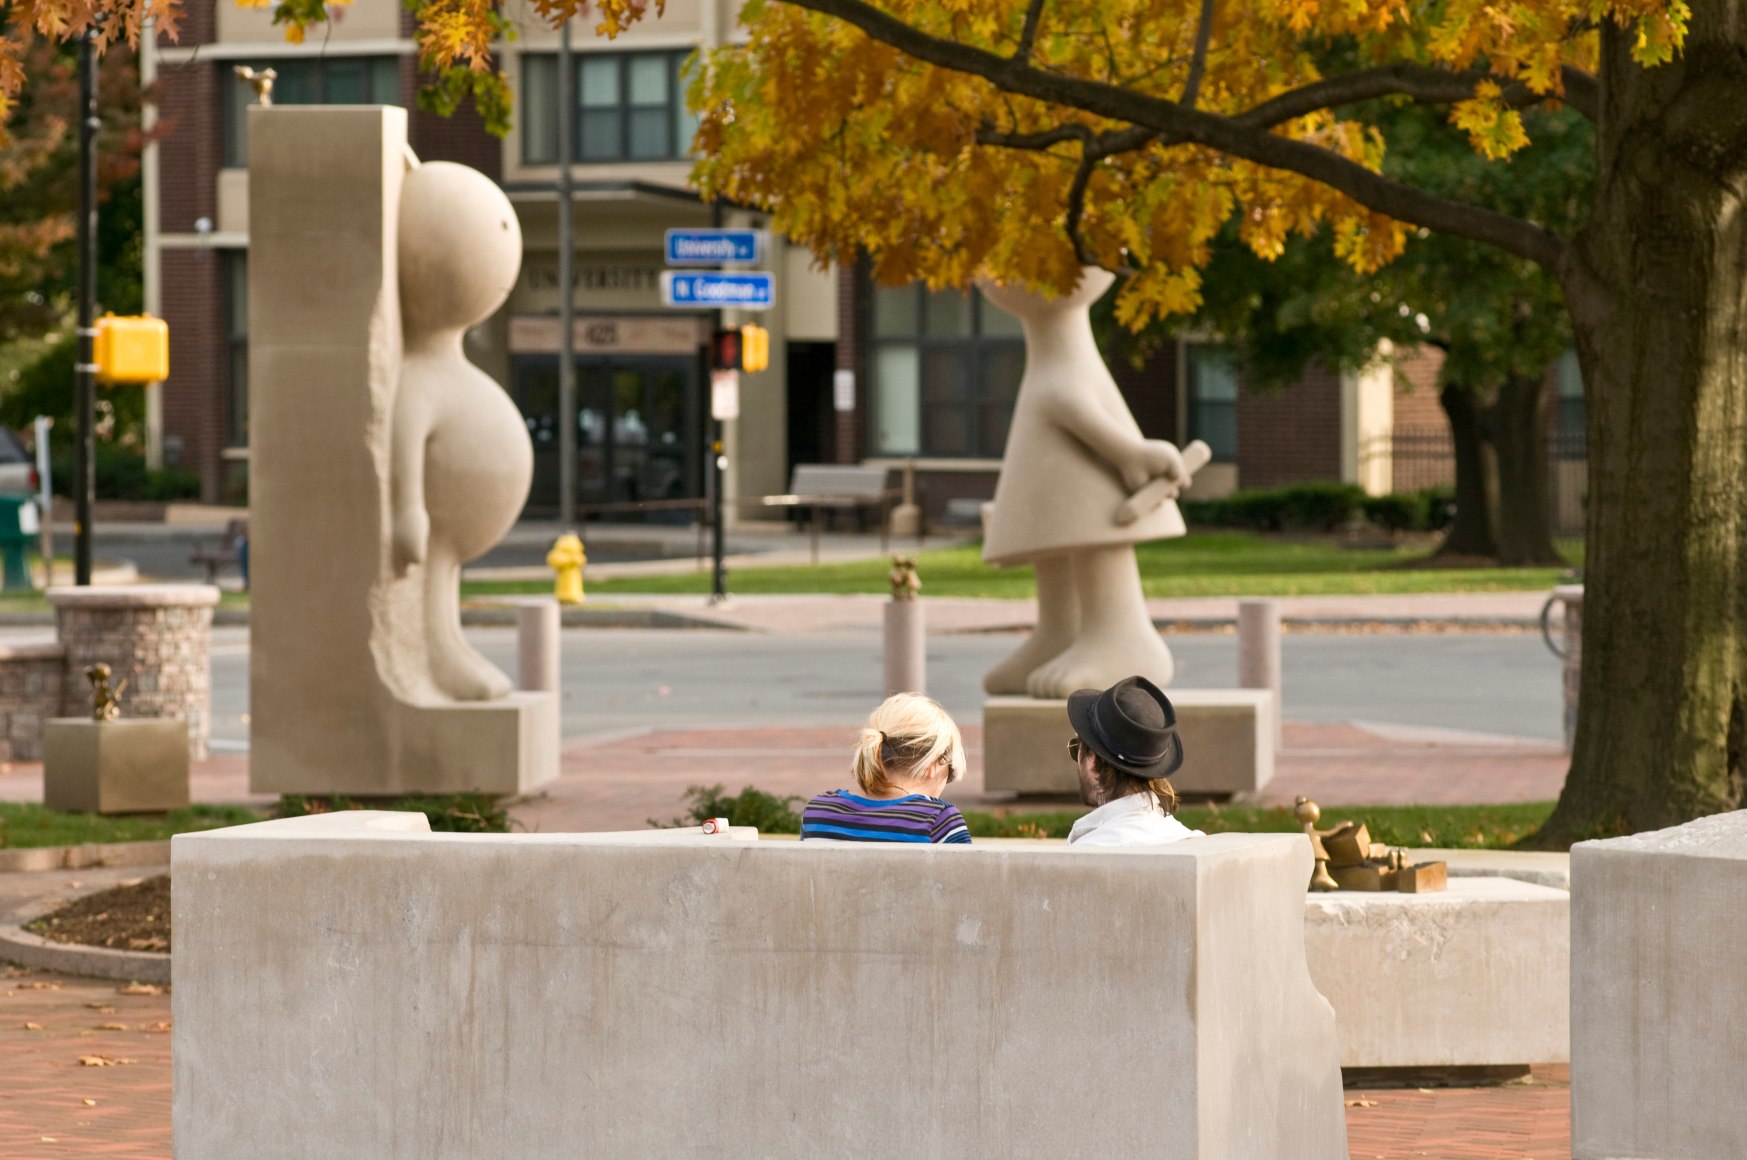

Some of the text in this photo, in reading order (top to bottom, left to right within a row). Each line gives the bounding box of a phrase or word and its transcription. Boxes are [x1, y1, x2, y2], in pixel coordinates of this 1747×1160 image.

[675, 236, 735, 258] University
[527, 266, 658, 290] UNVERSITY
[675, 279, 690, 298] N
[693, 278, 756, 300] Goodman
